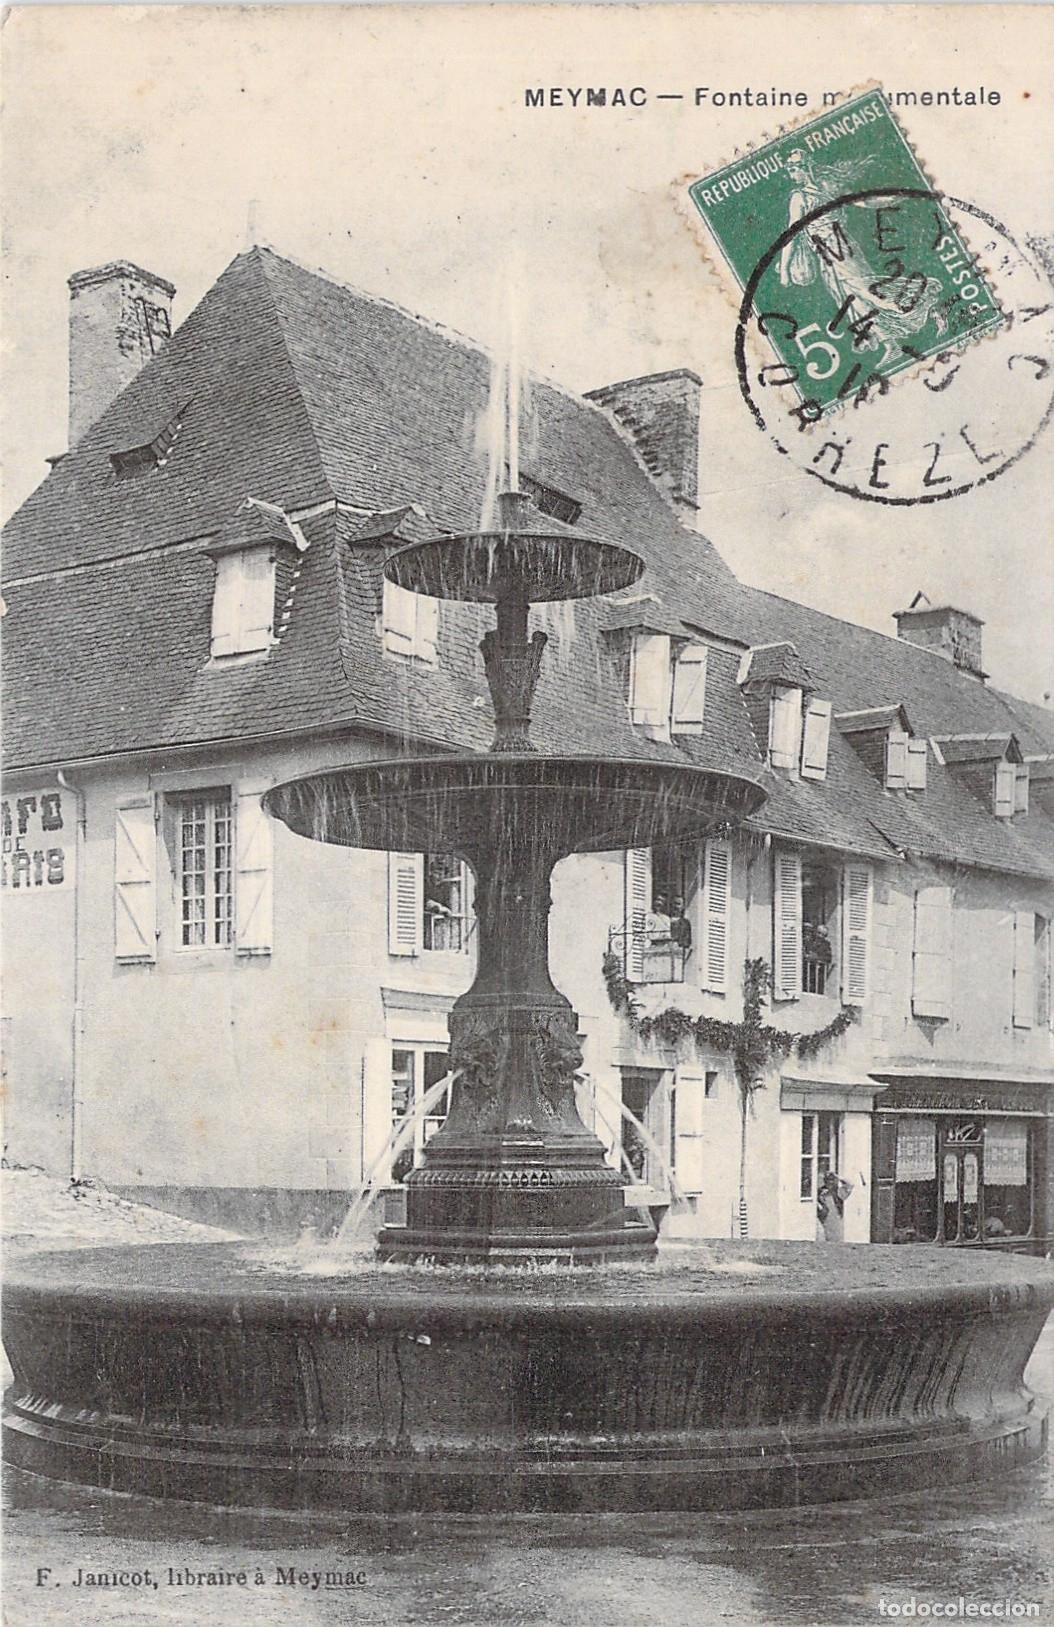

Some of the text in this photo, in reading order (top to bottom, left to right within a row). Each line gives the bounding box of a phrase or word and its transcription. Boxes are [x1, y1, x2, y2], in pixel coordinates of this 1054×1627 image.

[804, 101, 885, 152] FRANÇAISE
[938, 235, 989, 315] POSTES
[3, 836, 26, 853] DE
